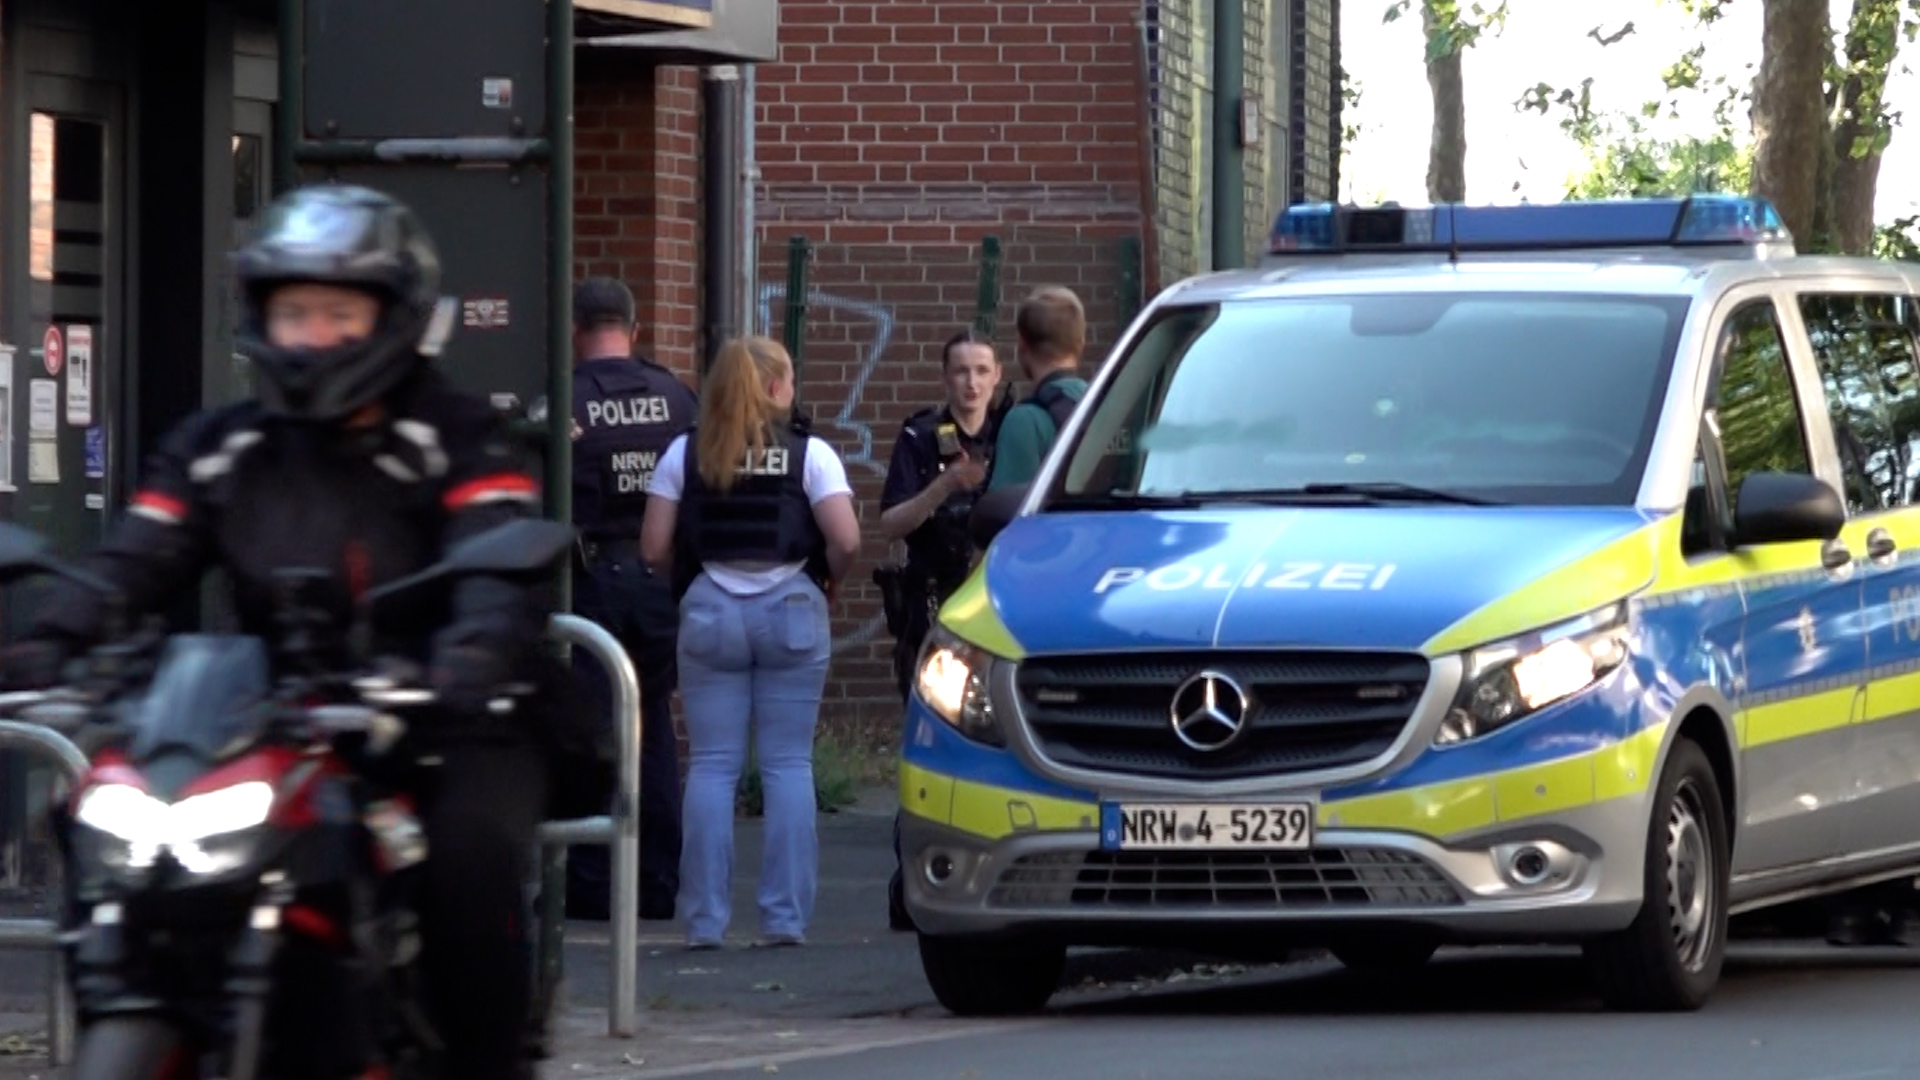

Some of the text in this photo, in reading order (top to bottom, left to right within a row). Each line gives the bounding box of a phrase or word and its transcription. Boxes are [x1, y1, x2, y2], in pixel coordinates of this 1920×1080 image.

[586, 396, 670, 427] POLIZEI
[612, 451, 657, 472] NRW
[1093, 562, 1397, 593] POLIZEI
[1121, 809, 1306, 843] NRW 4-5239
